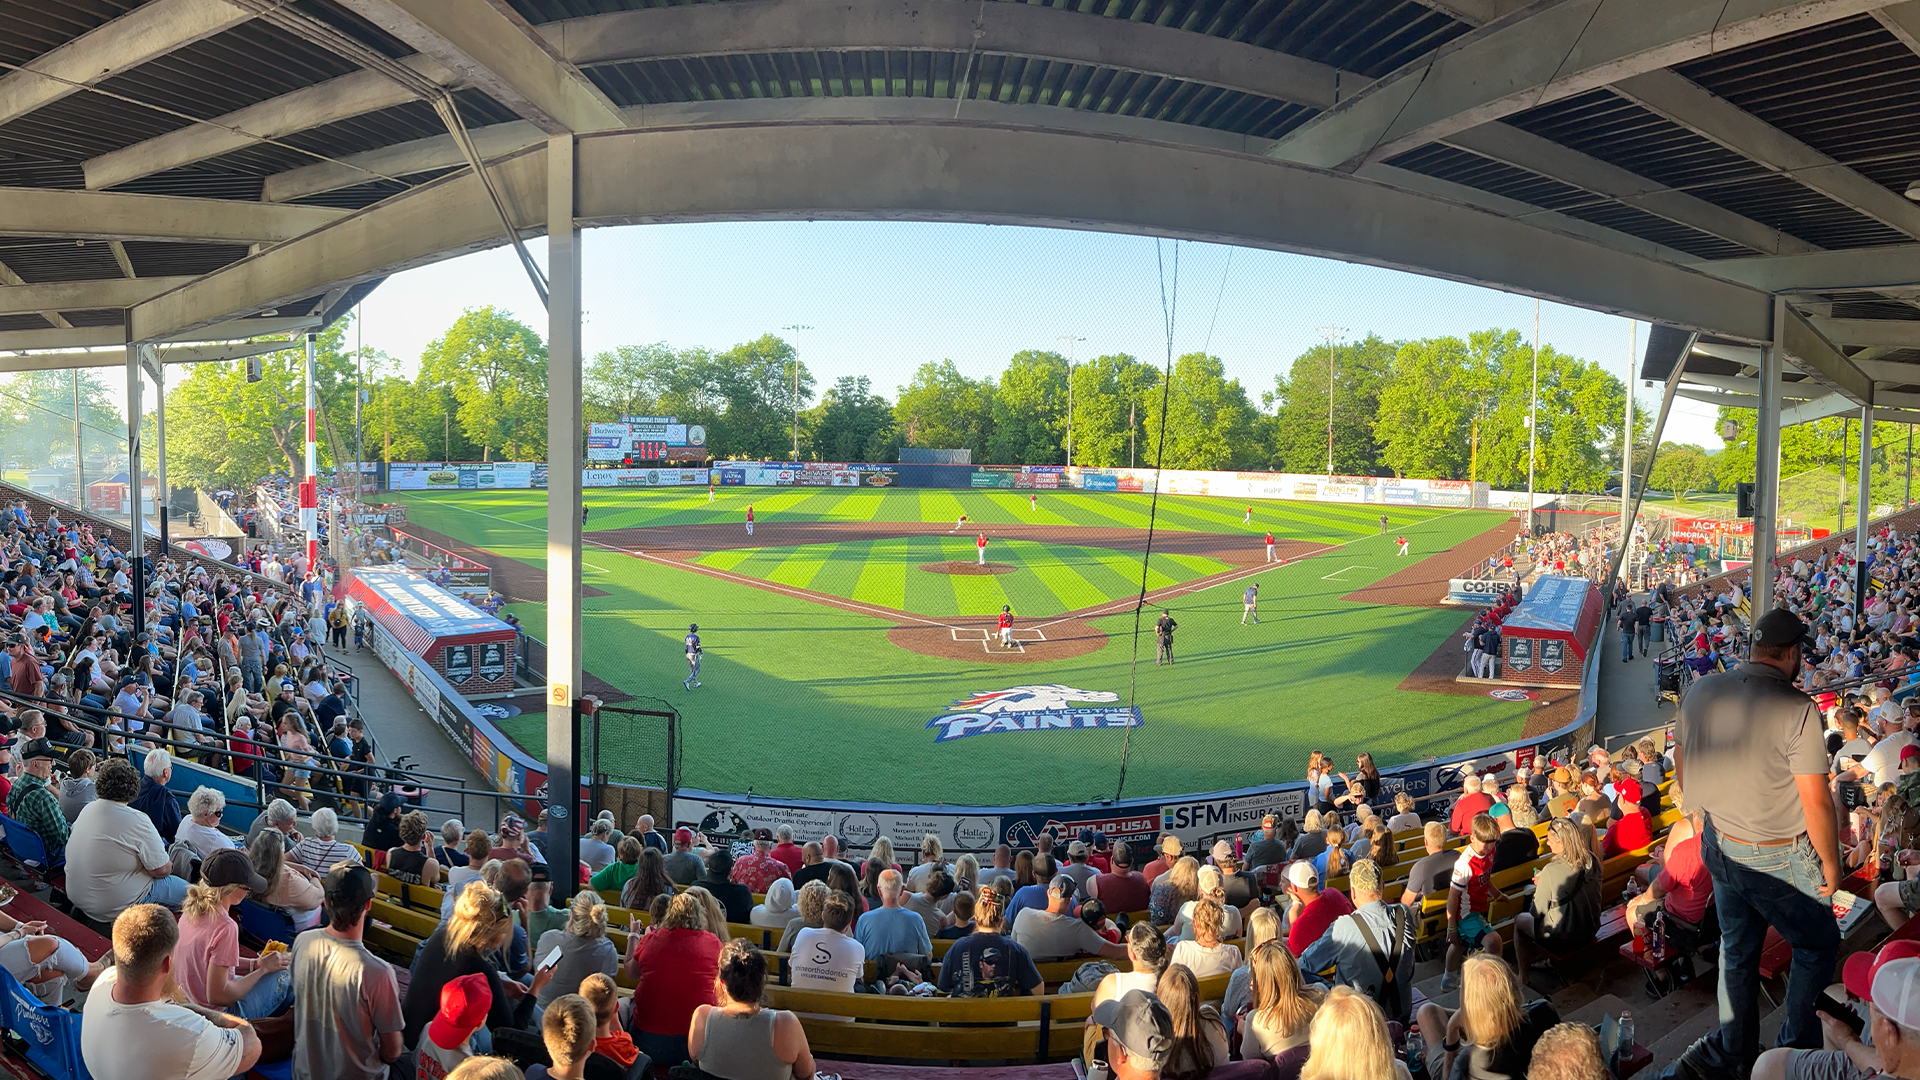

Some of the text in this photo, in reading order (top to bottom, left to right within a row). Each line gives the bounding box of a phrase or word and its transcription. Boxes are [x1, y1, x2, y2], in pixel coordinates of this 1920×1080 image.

[594, 427, 627, 435] Budweiser
[587, 471, 613, 480] Lenox
[357, 513, 387, 524] VFW
[1692, 521, 1715, 530] JACK
[934, 712, 1138, 740] PAINTS
[1380, 778, 1427, 796] welers
[1846, 788, 1855, 806] 1776
[782, 810, 809, 818] Ultimate
[1175, 803, 1228, 829] SFM
[1228, 804, 1300, 823] INSURACE
[746, 814, 773, 822] Outdoor
[774, 817, 795, 825] Drama
[845, 822, 874, 833] Haller
[960, 828, 988, 837] Haller
[15, 1002, 50, 1028] Panthers
[419, 1049, 448, 1080] SNYDE
